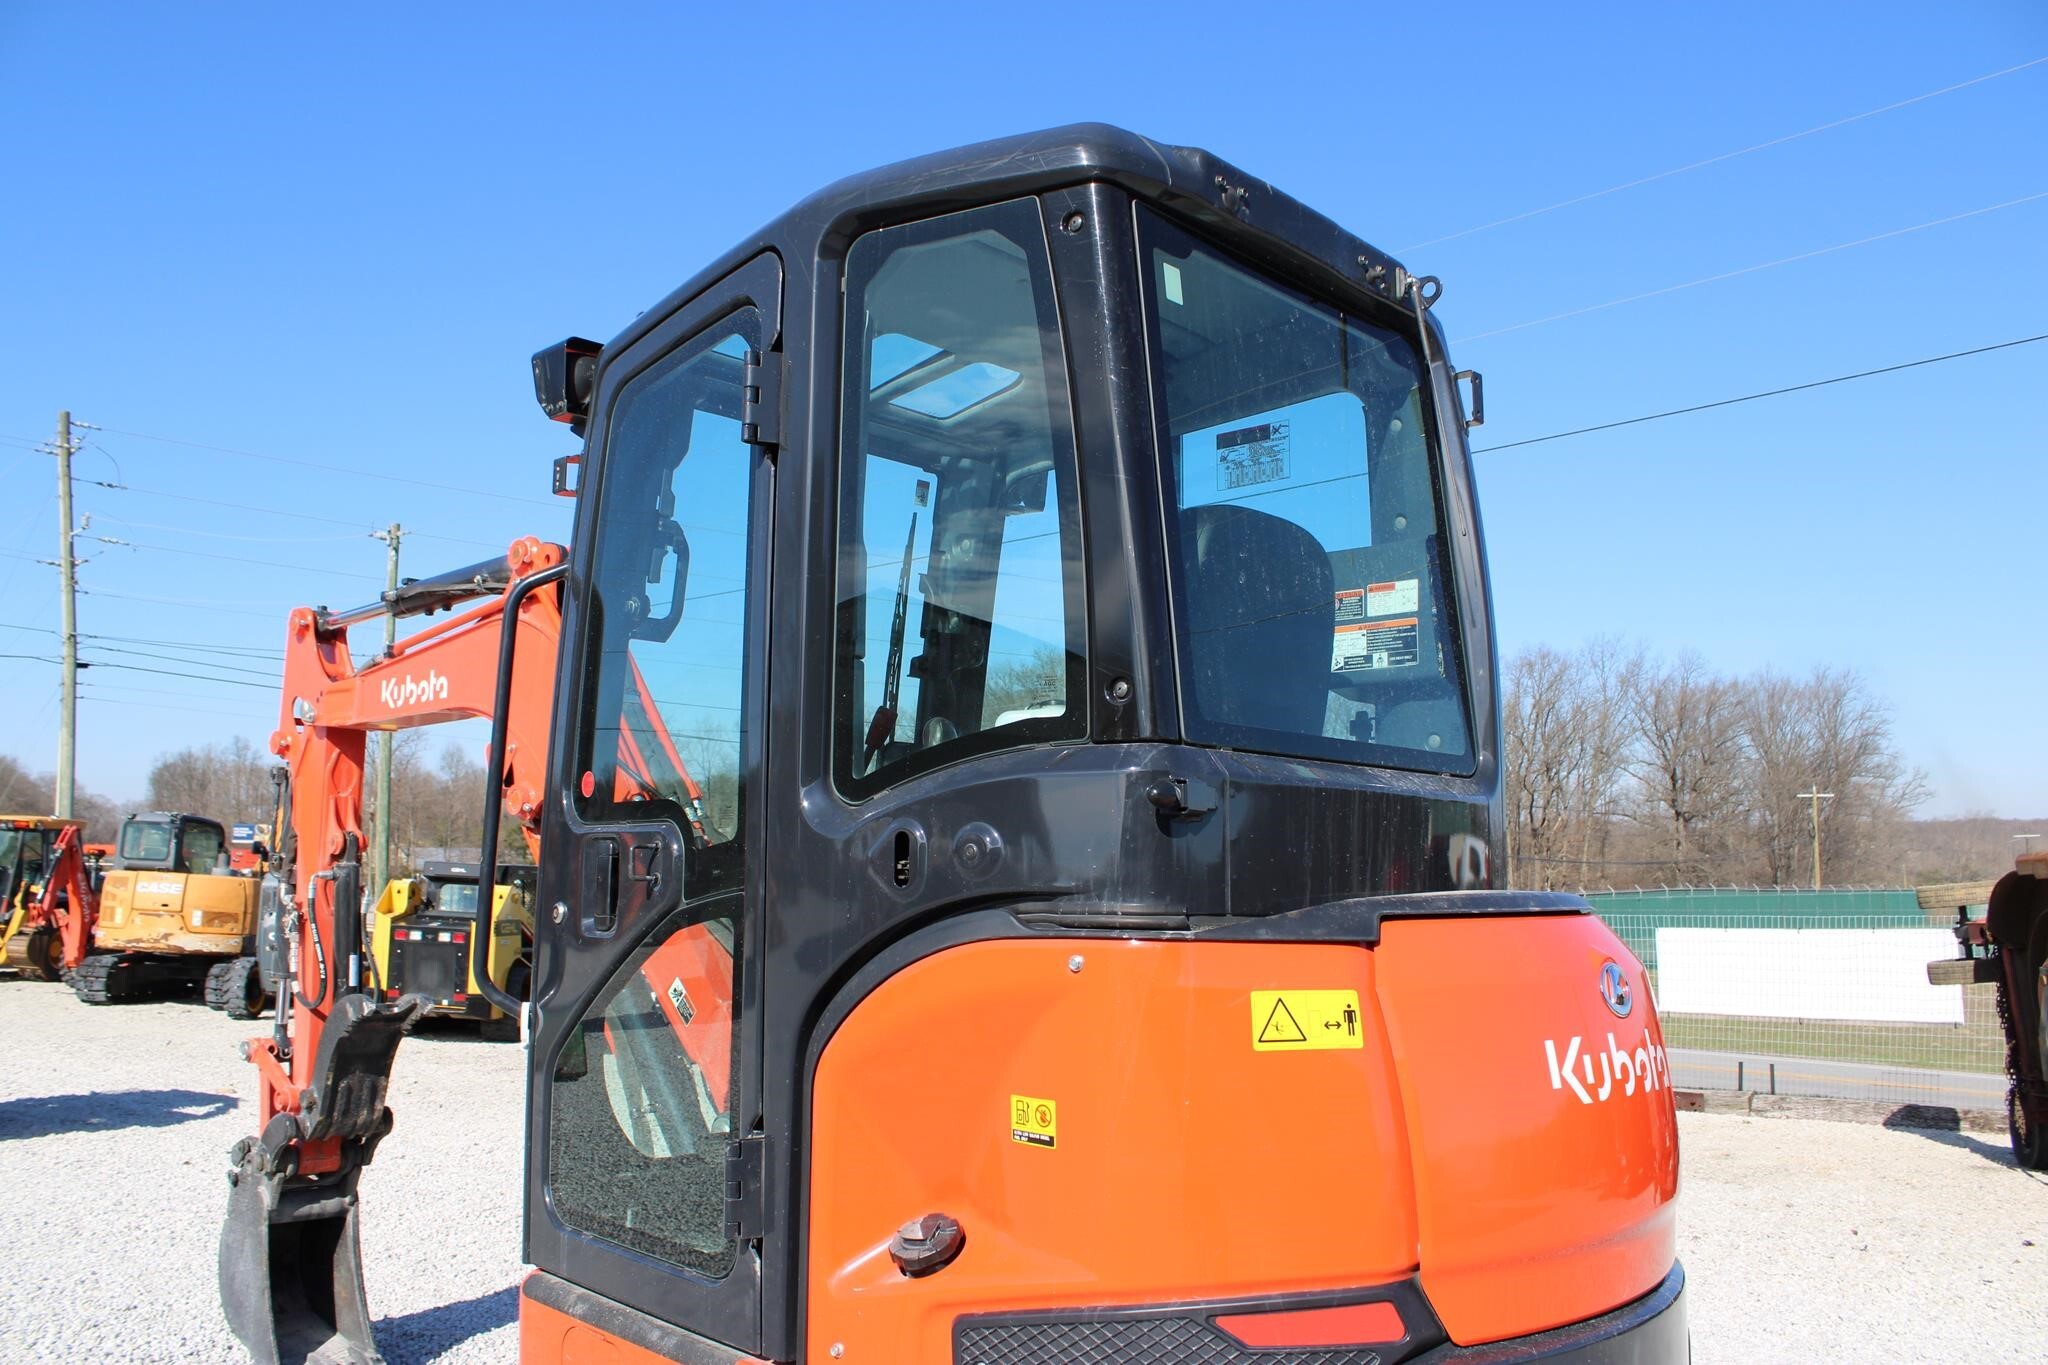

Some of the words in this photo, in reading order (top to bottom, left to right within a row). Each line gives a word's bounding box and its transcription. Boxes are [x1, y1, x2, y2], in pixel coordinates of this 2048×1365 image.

[381, 669, 448, 709] Kubota
[136, 882, 184, 895] CASE
[1544, 1028, 1671, 1105] Kubota
